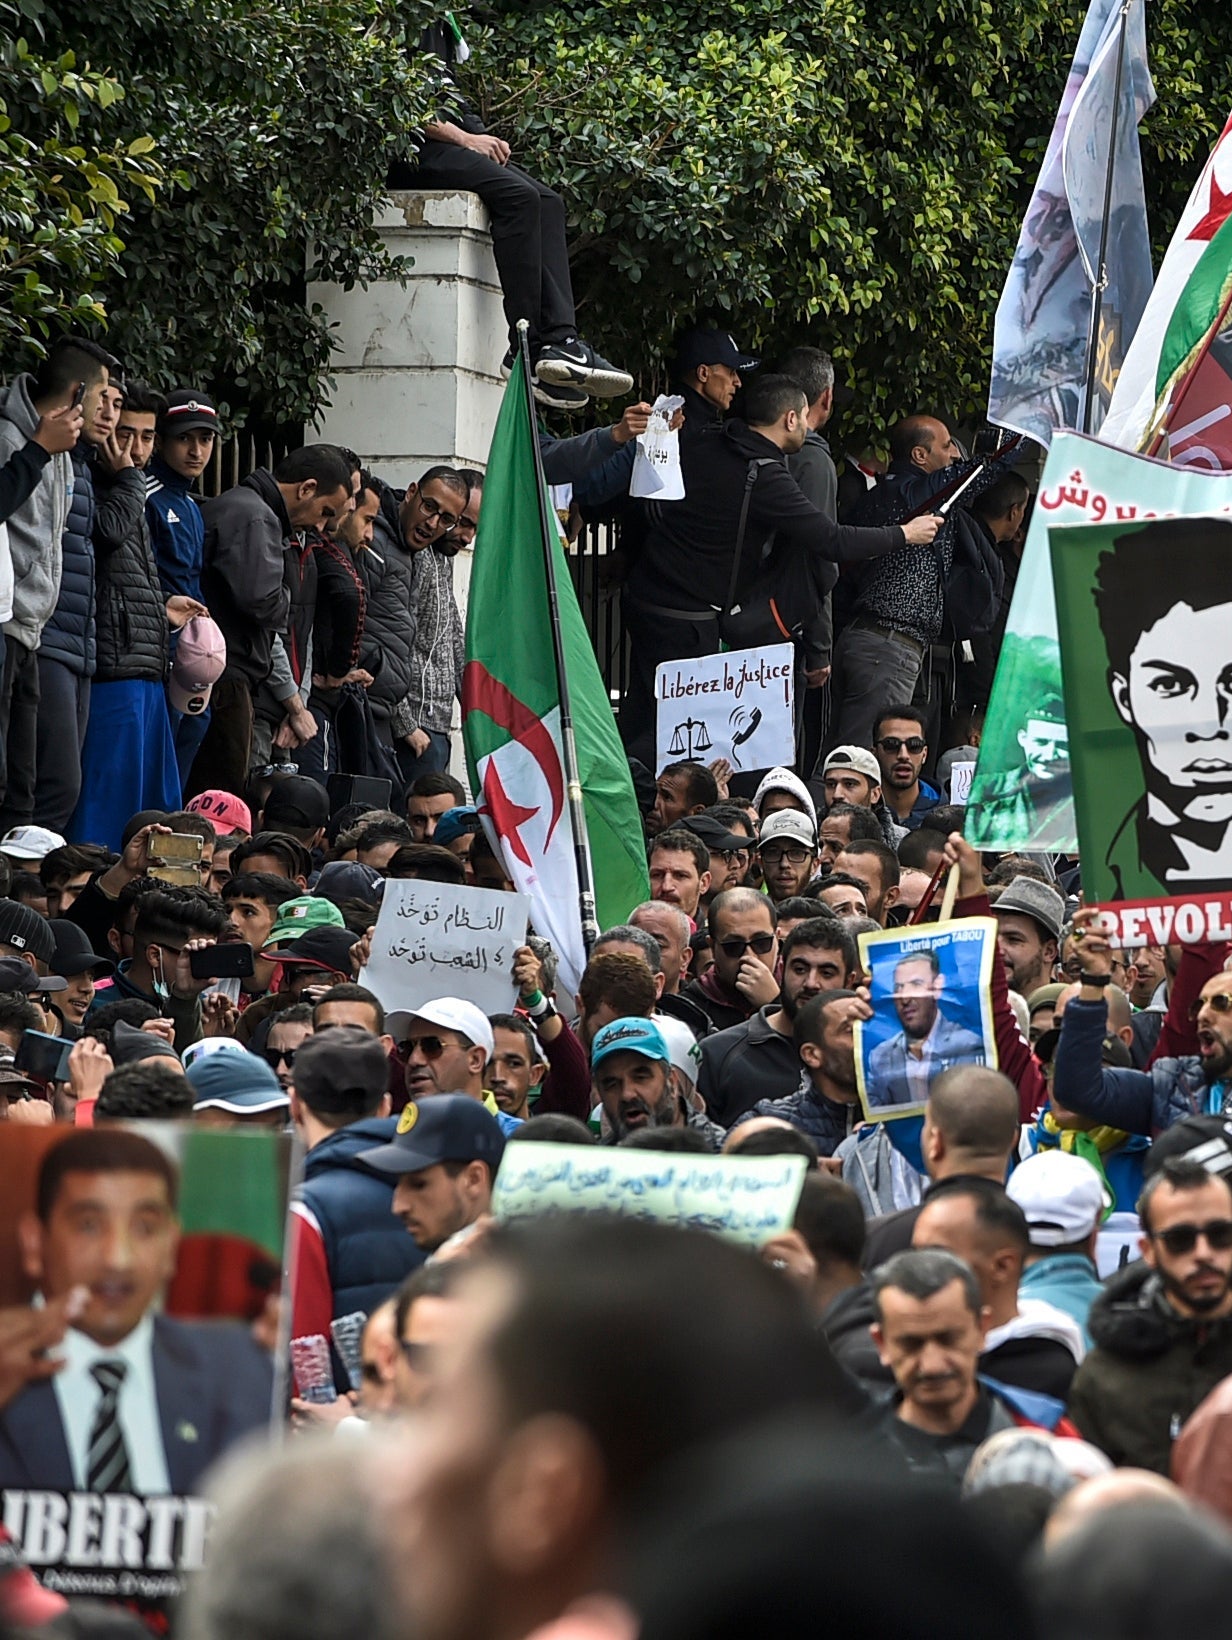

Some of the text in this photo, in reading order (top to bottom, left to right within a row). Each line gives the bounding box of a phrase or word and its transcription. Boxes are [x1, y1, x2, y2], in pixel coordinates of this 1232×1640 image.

[662, 671, 721, 700] Libérez
[723, 662, 734, 692] la
[734, 658, 791, 699] justice
[900, 929, 983, 954] Liberté pour TABOU
